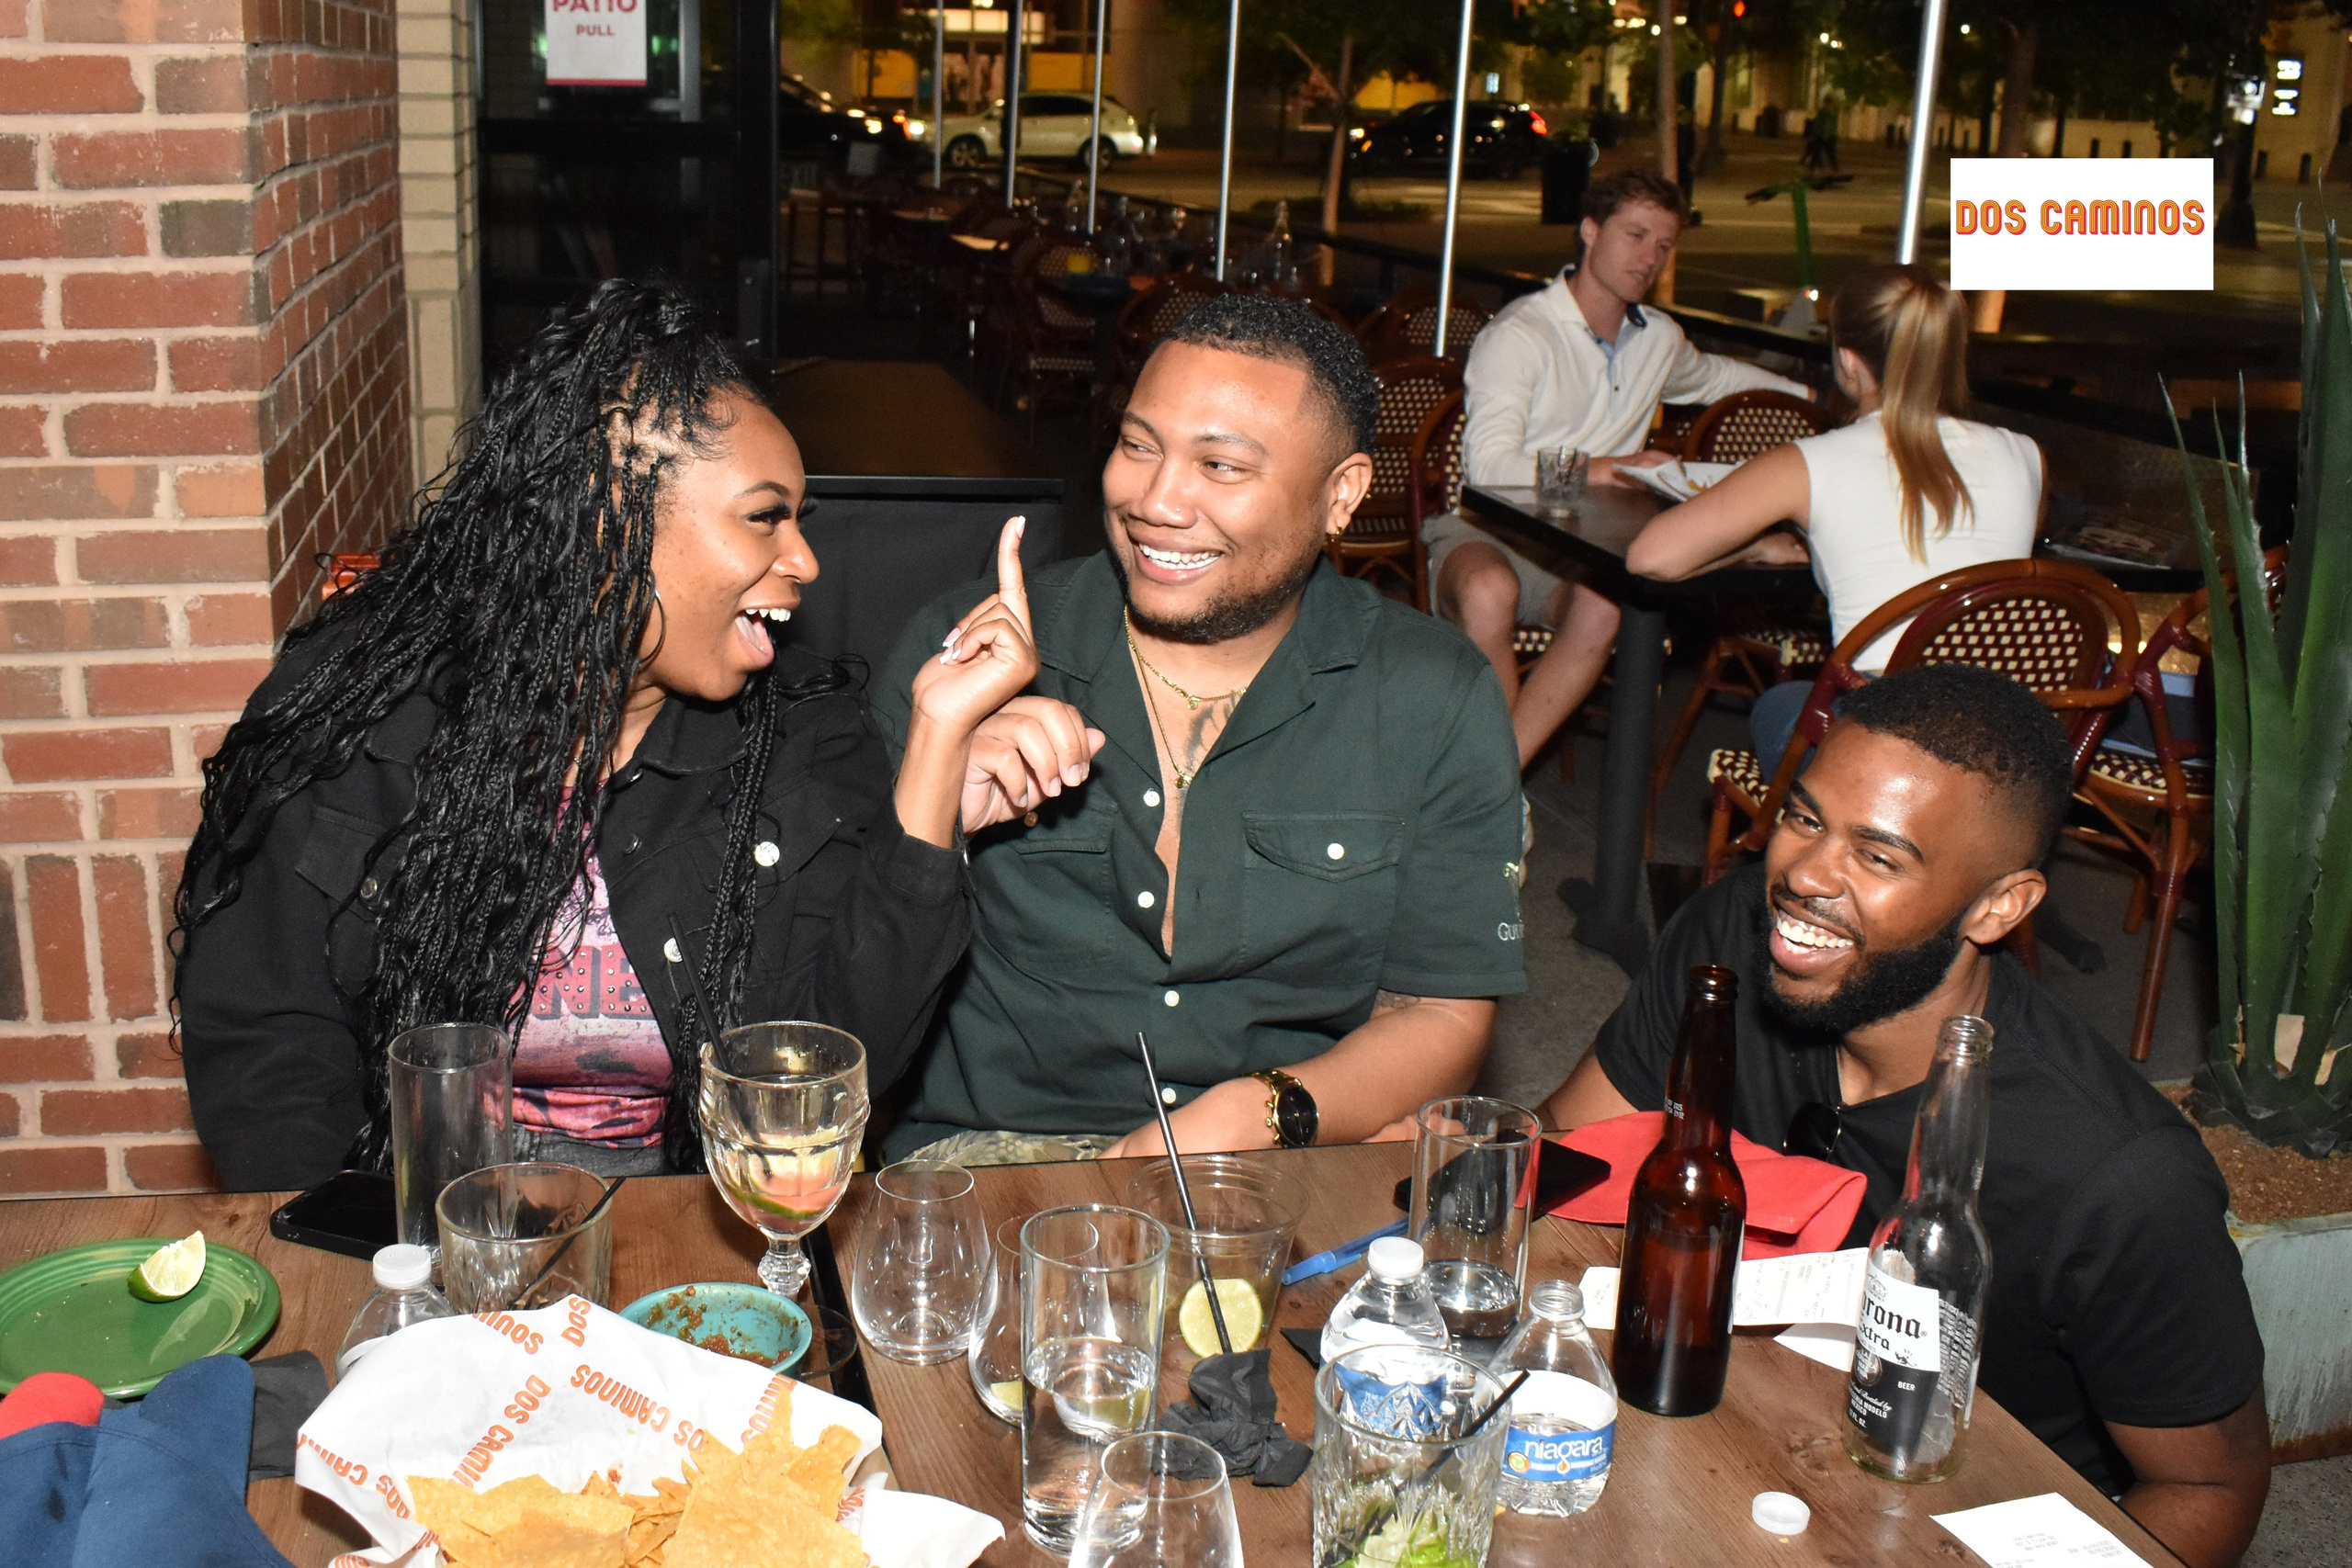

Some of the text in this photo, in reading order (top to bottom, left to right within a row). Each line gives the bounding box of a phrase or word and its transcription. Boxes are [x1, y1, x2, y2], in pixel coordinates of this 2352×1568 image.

[552, 0, 638, 13] PATIO
[576, 25, 616, 37] PULL
[560, 1297, 592, 1348] DOS
[504, 1373, 552, 1425] DOS
[570, 1364, 672, 1433] CAMINOS
[1897, 1381, 1916, 1392] BEER
[1863, 1401, 1888, 1419] MODELO
[1525, 1436, 1602, 1474] niagara
[376, 1474, 411, 1520] DOS
